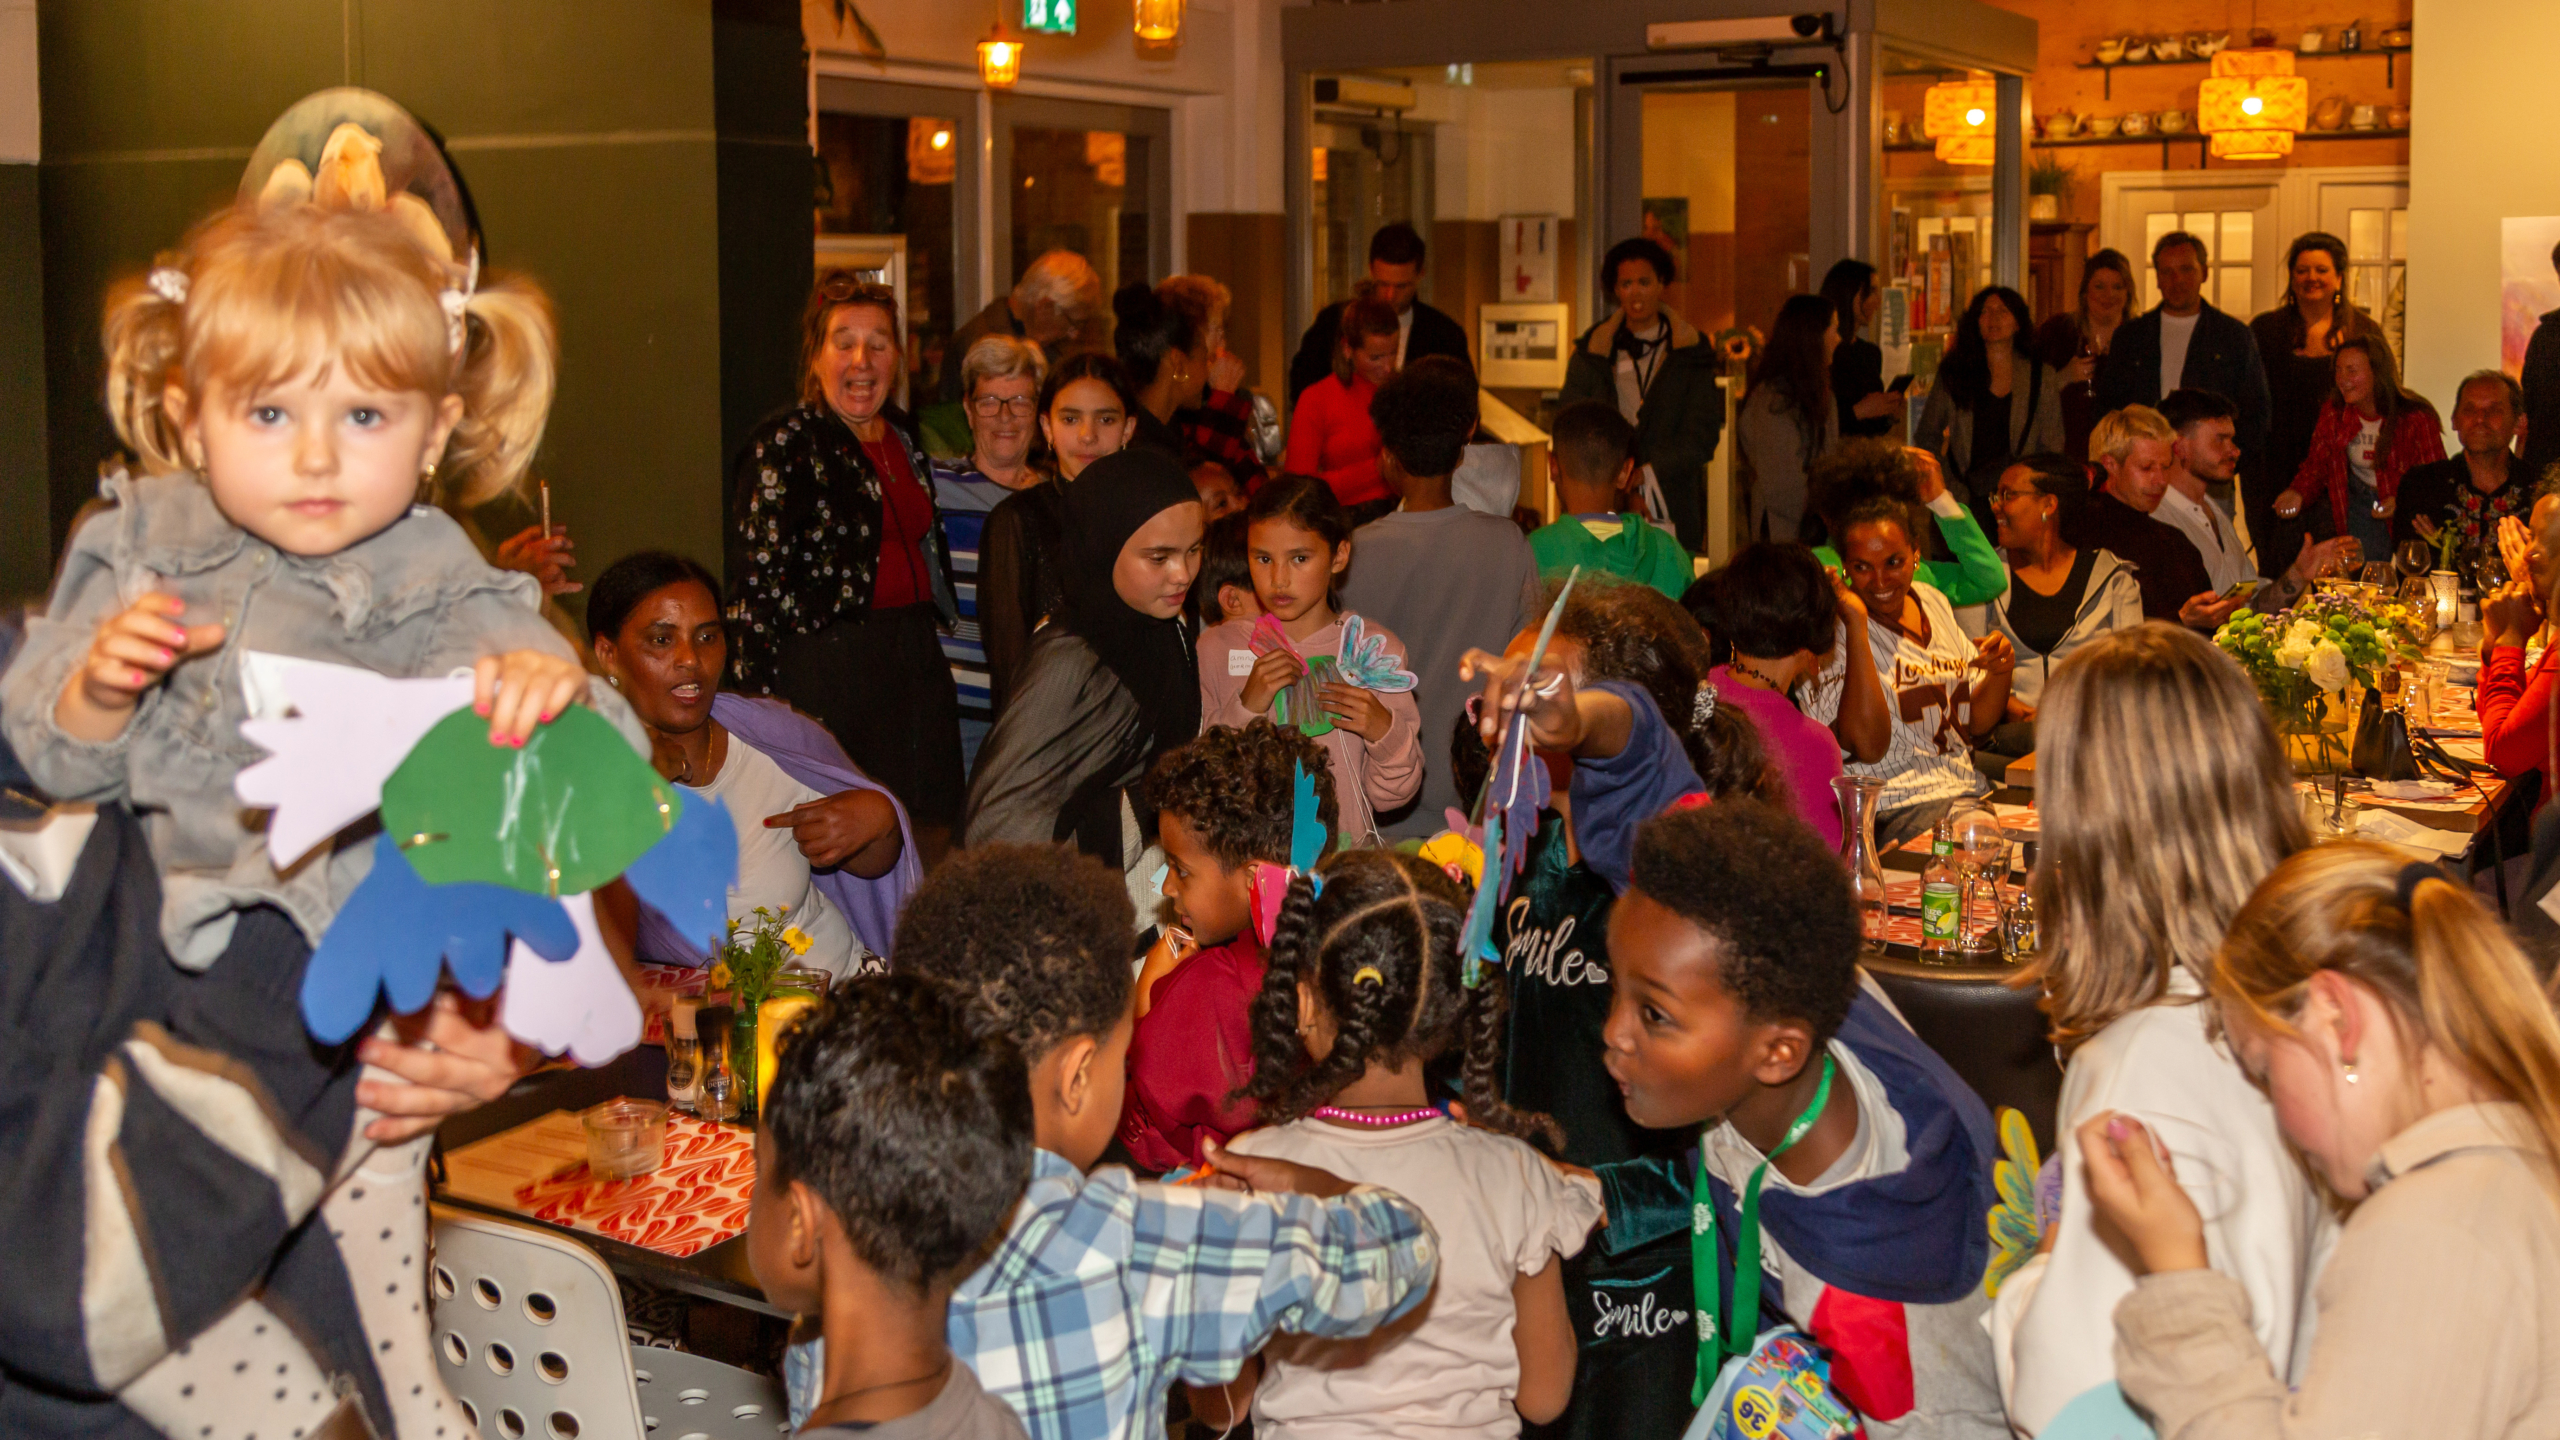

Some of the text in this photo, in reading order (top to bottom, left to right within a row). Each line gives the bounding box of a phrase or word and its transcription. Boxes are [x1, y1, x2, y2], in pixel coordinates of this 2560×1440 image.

[1895, 657, 1925, 689] Los
[1924, 904, 1942, 917] fuze
[1505, 896, 1586, 986] Smile
[1593, 1290, 1673, 1338] Smile
[1738, 1401, 1767, 1431] 36
